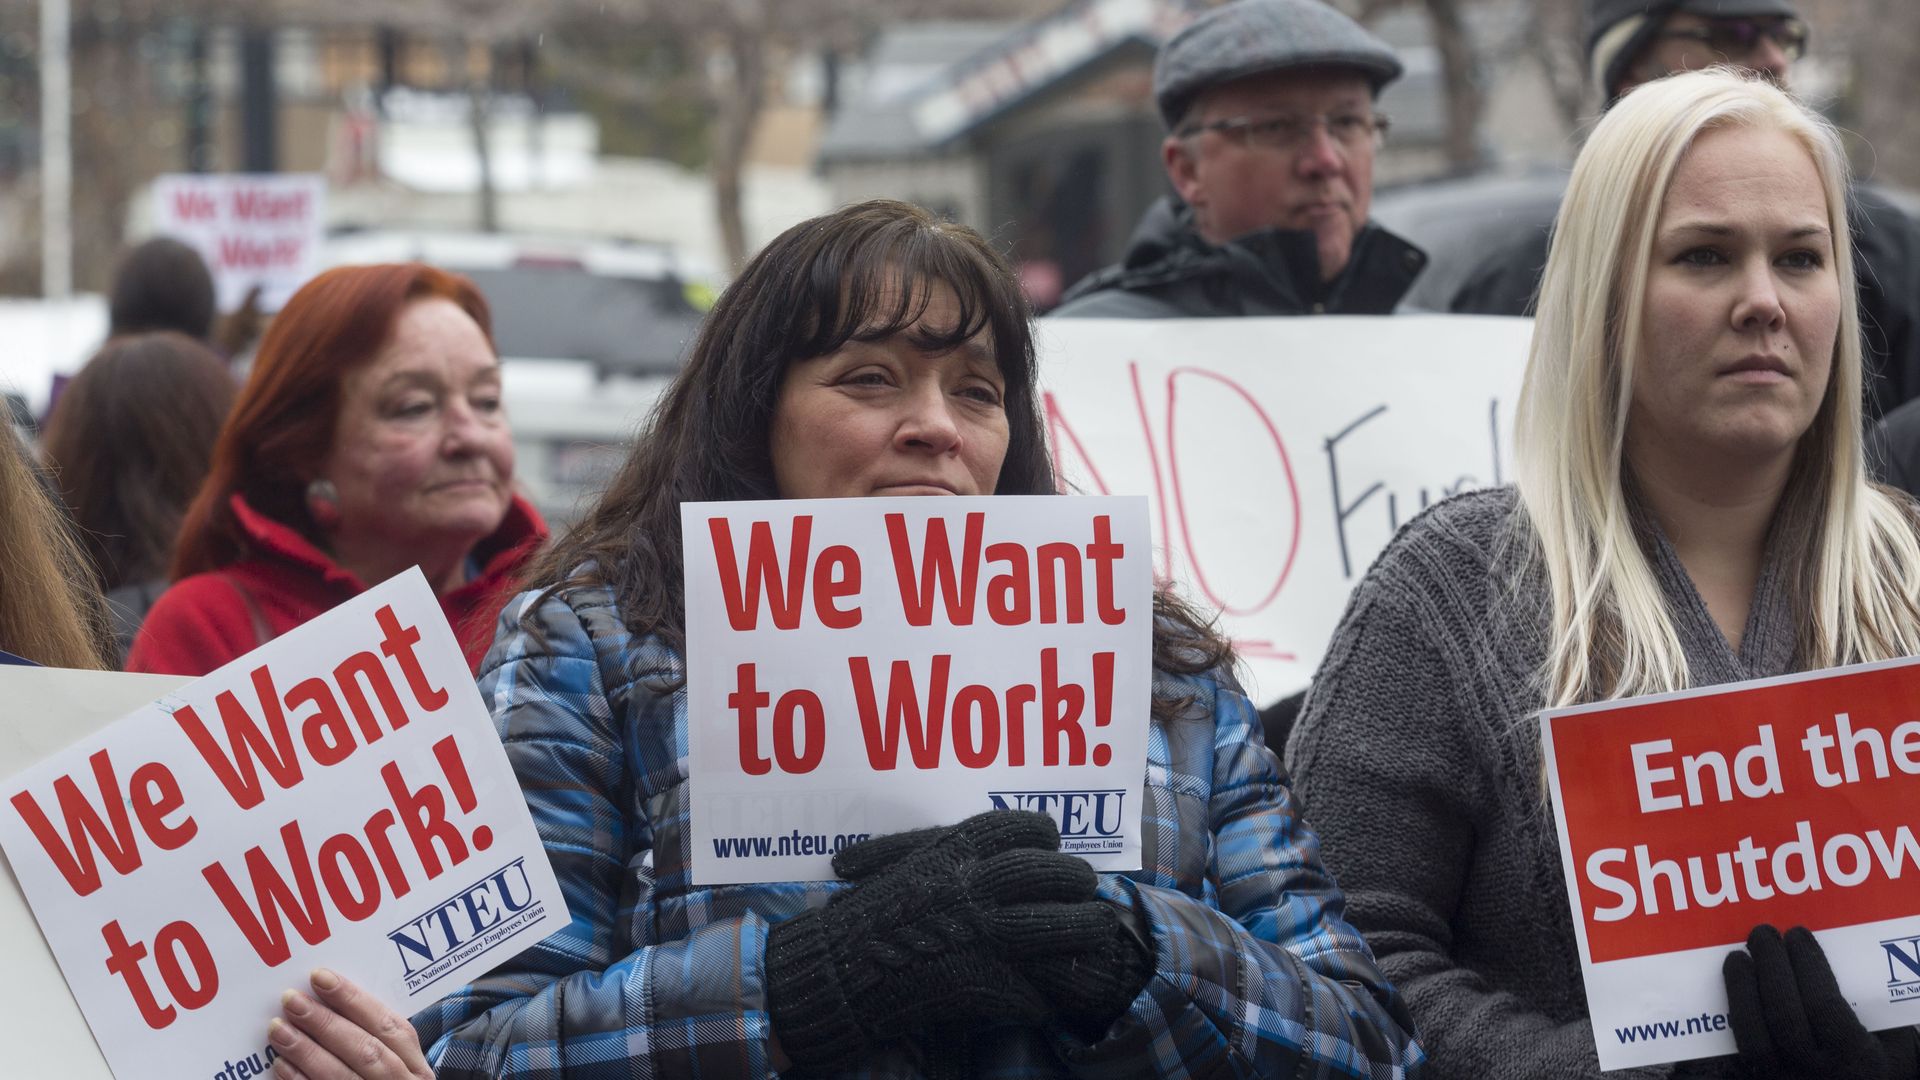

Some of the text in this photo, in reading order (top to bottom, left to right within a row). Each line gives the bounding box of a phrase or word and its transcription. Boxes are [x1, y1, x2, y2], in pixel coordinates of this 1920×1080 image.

[709, 512, 1126, 631] We Want
[11, 604, 449, 897] We Want
[728, 648, 1115, 776] to Work!
[1630, 712, 1920, 814] End the
[101, 734, 494, 1030] to Work!
[1064, 841, 1101, 851] Employees
[1102, 840, 1123, 849] Union
[1585, 820, 1920, 922] Shutdow
[388, 859, 533, 978] NTEU
[406, 905, 545, 990] The National Treasury Employees Union
[1615, 1012, 1731, 1044] www.nte
[1889, 987, 1905, 997] The
